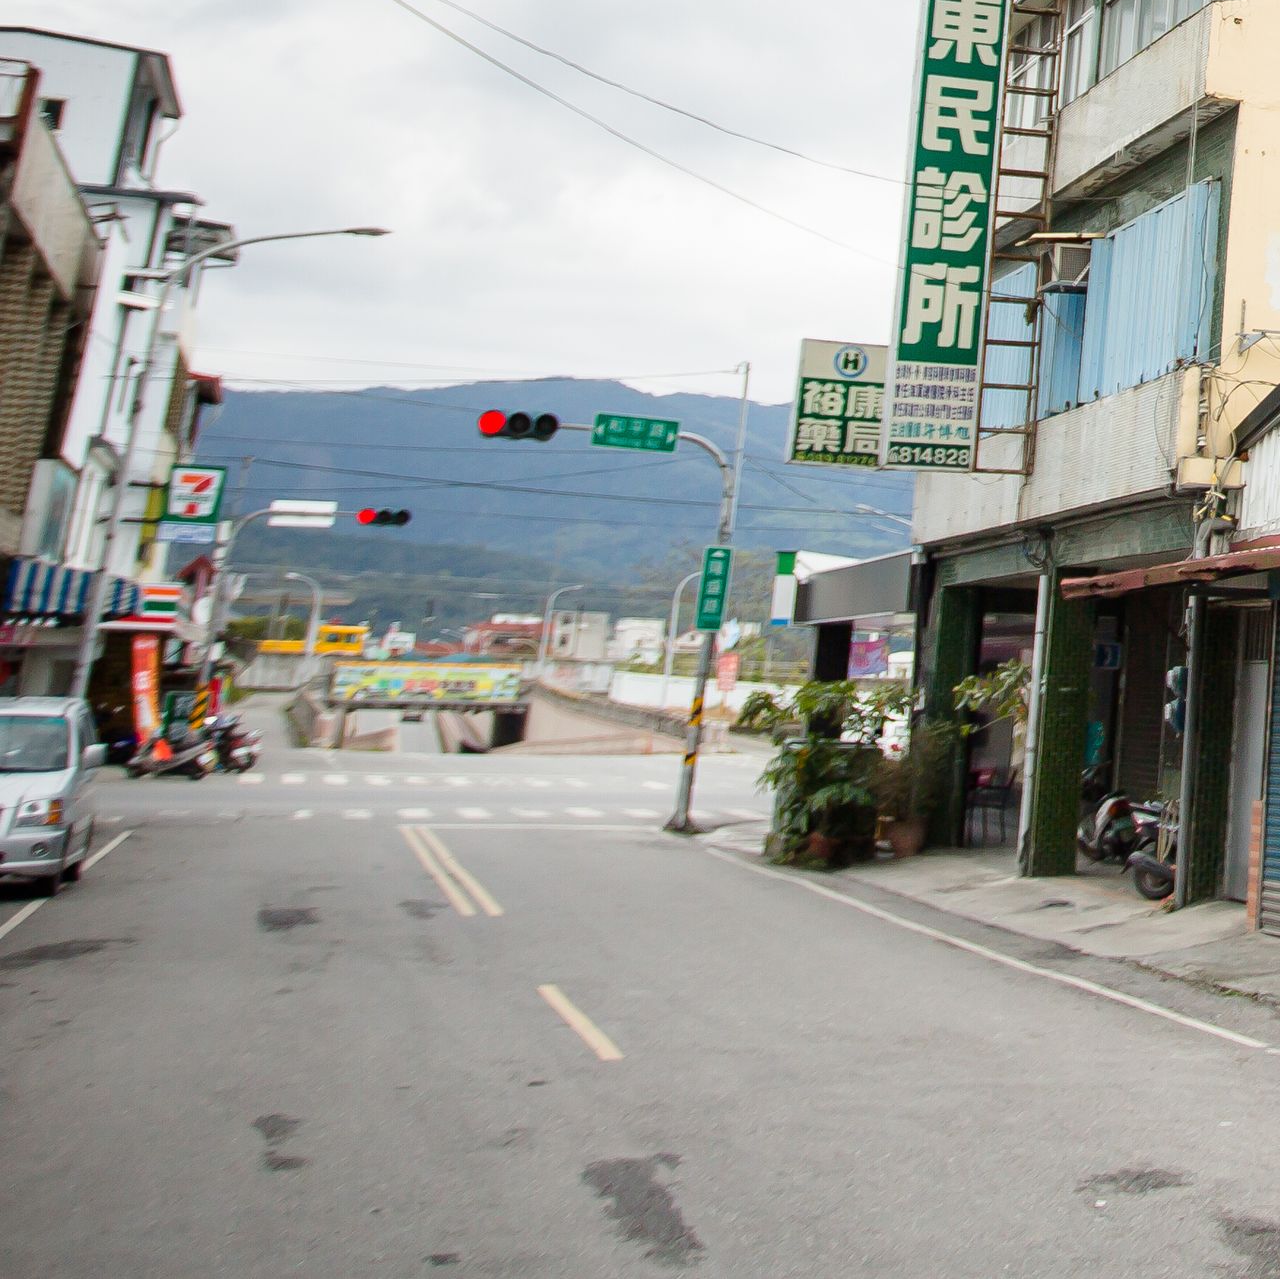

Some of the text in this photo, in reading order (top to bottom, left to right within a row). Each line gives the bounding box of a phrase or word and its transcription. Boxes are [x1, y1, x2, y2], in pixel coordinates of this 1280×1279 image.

[803, 380, 885, 418] 裕康
[796, 417, 882, 456] 藥局
[899, 446, 970, 465] 814828
